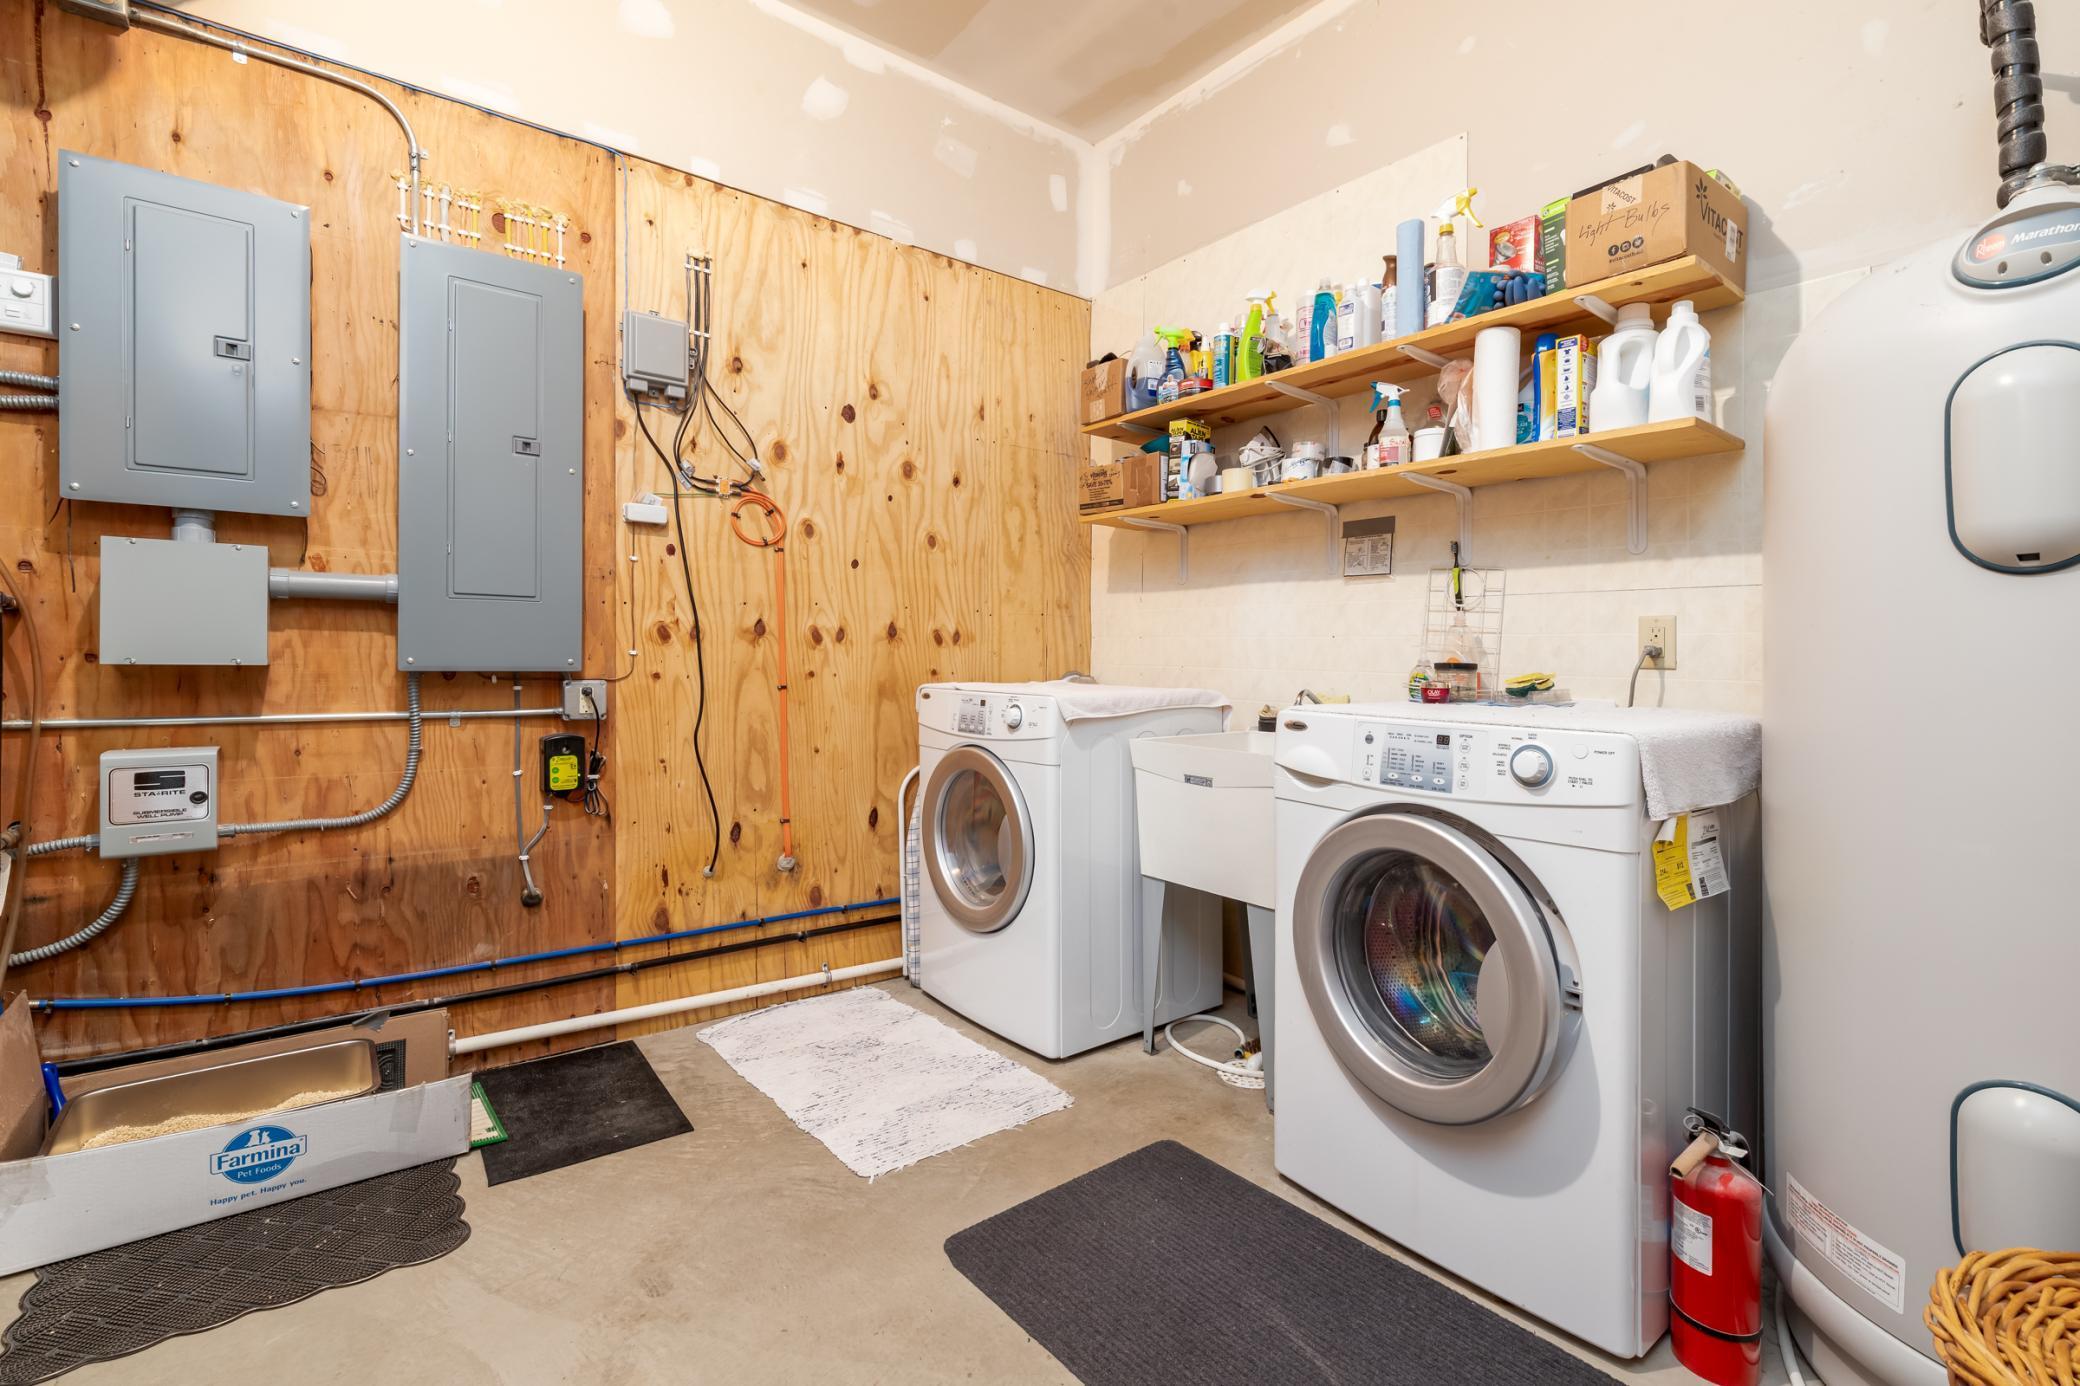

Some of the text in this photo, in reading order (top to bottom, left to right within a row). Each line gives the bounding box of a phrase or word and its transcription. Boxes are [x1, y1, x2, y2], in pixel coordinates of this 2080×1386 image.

[1607, 185, 1636, 203] VITACOST
[1579, 201, 1671, 246] Light Bulbs
[1700, 200, 1743, 249] VITACT
[217, 1143, 301, 1171] Farmina
[237, 1163, 282, 1179] Pet Foods
[210, 1178, 307, 1206] Happy pet. Happy you.
